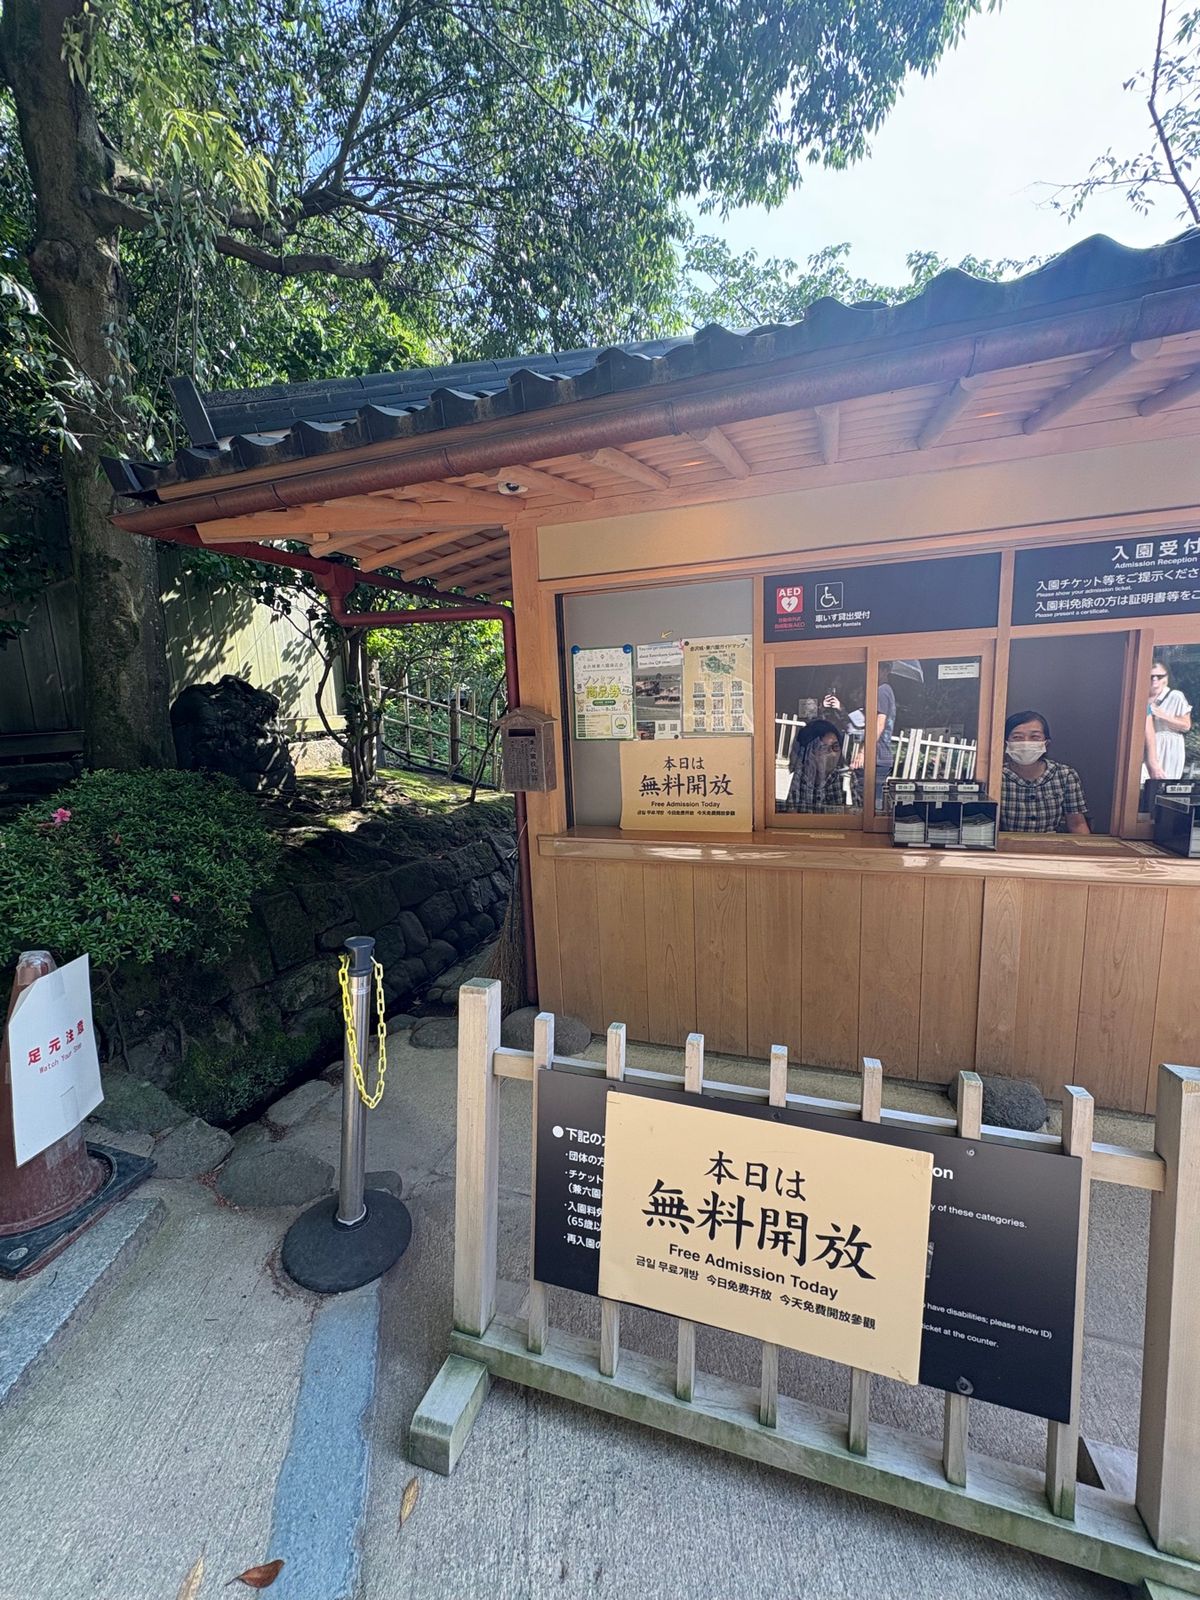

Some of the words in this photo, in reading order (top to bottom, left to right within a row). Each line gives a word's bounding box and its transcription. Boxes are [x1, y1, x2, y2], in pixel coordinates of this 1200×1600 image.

[1111, 538, 1200, 561] 入園受付
[1114, 560, 1155, 570] Admission
[1157, 556, 1198, 566] Reception
[1036, 568, 1200, 592] 入園チケット等をご提示くださ
[1085, 587, 1114, 595] admission
[778, 587, 802, 598] AED
[815, 610, 870, 622] 車いす貸出受付
[815, 622, 842, 630] Wheelchair
[663, 756, 705, 771] 本日は
[638, 773, 734, 797] 無料開放
[701, 801, 721, 809] Today
[28, 1019, 84, 1066] 足元注意
[39, 1059, 59, 1073] Watch
[704, 1150, 806, 1201] 本日は
[937, 1204, 947, 1213] of
[949, 1205, 974, 1218] these
[975, 1212, 1028, 1229] categories.
[641, 1179, 876, 1280] 無料開放
[636, 1255, 656, 1269] 금일
[658, 1260, 699, 1281] 무료개방
[706, 1274, 772, 1301] 今日免费开放
[669, 1243, 701, 1262] Free
[704, 1252, 785, 1285] Admission
[790, 1274, 839, 1301] Today
[927, 1302, 945, 1314] have
[946, 1307, 989, 1324] disabilities;
[990, 1318, 1016, 1331] please
[1017, 1325, 1040, 1337] show
[1041, 1329, 1053, 1340] ID)
[943, 1328, 951, 1336] at
[952, 1329, 966, 1340] the
[967, 1334, 999, 1349] counter.
